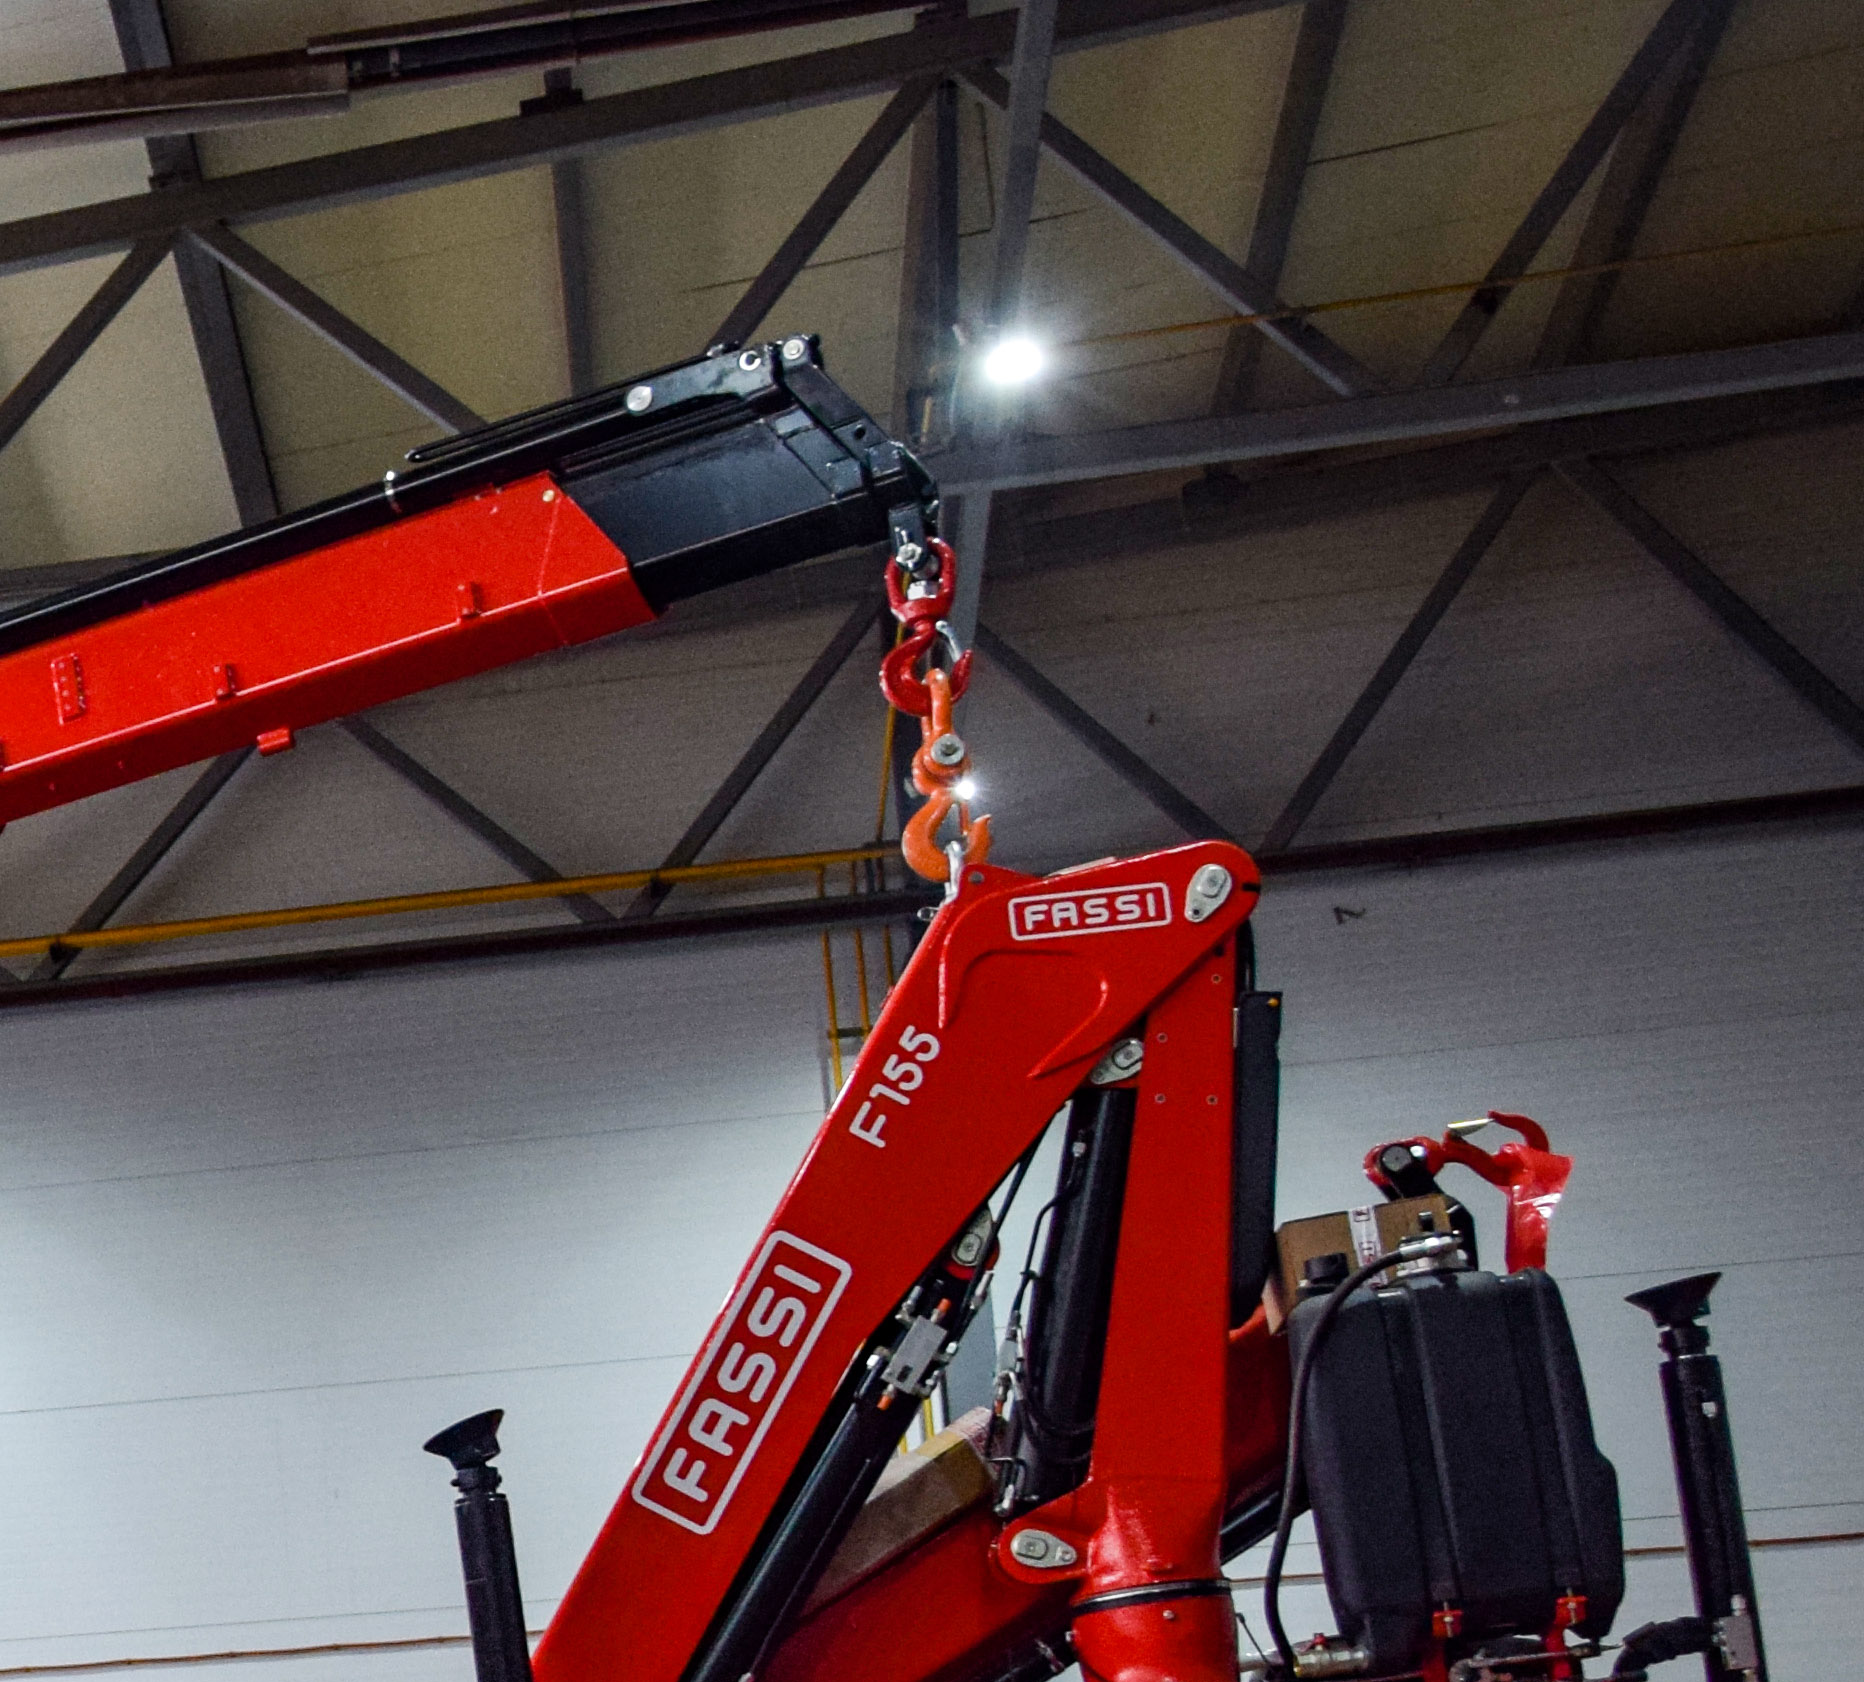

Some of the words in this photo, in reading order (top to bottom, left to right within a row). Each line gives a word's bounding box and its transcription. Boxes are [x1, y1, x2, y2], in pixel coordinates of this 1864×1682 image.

[1023, 886, 1165, 930] FASSI
[849, 1025, 941, 1149] F155
[664, 1264, 821, 1502] FASSI
